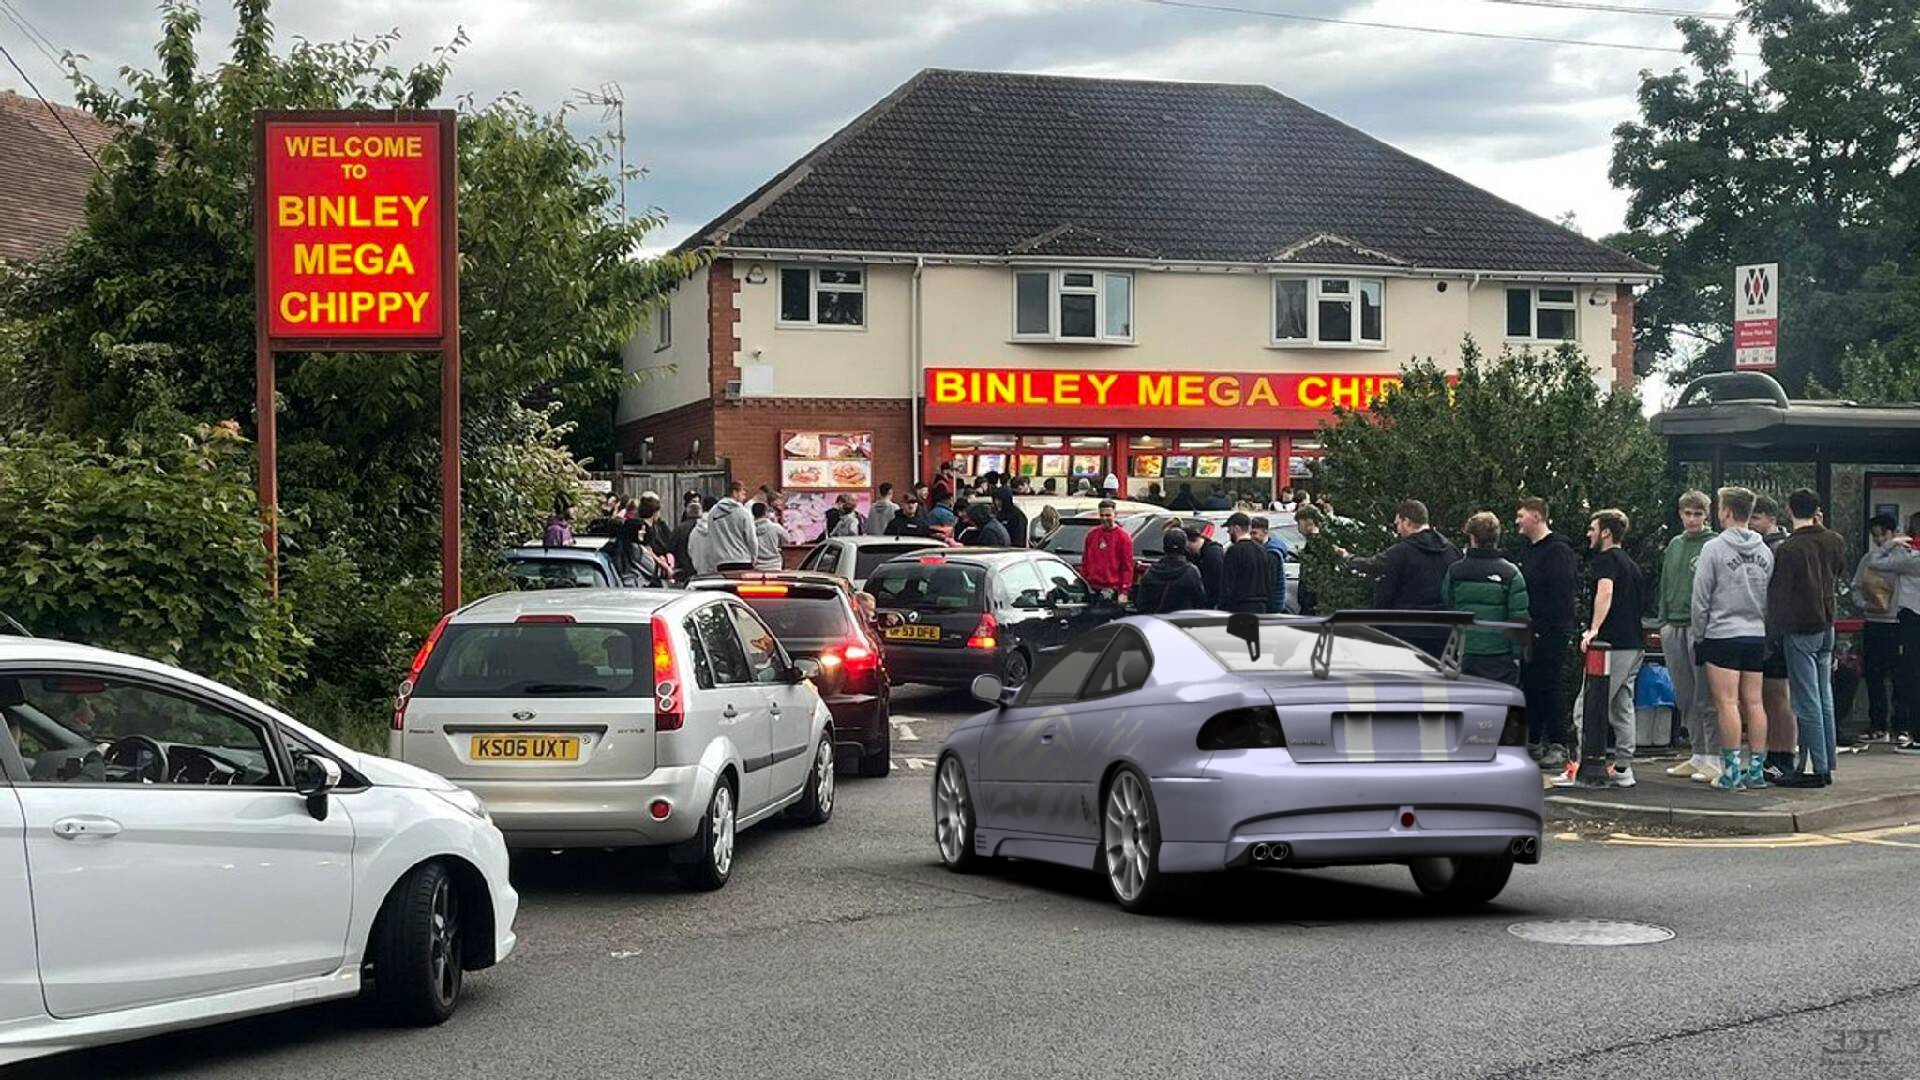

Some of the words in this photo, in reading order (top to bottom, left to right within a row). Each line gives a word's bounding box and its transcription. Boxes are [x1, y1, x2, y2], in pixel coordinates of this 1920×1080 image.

[285, 136, 423, 158] WELCOME
[341, 164, 368, 180] TO
[277, 195, 429, 228] BINLEY
[293, 243, 415, 275] MEGA
[279, 291, 430, 324] CHIPPY
[935, 371, 1119, 405] BINLEY
[1138, 374, 1280, 407] MEGA
[478, 739, 528, 758] KS06
[532, 739, 571, 758] UXT
